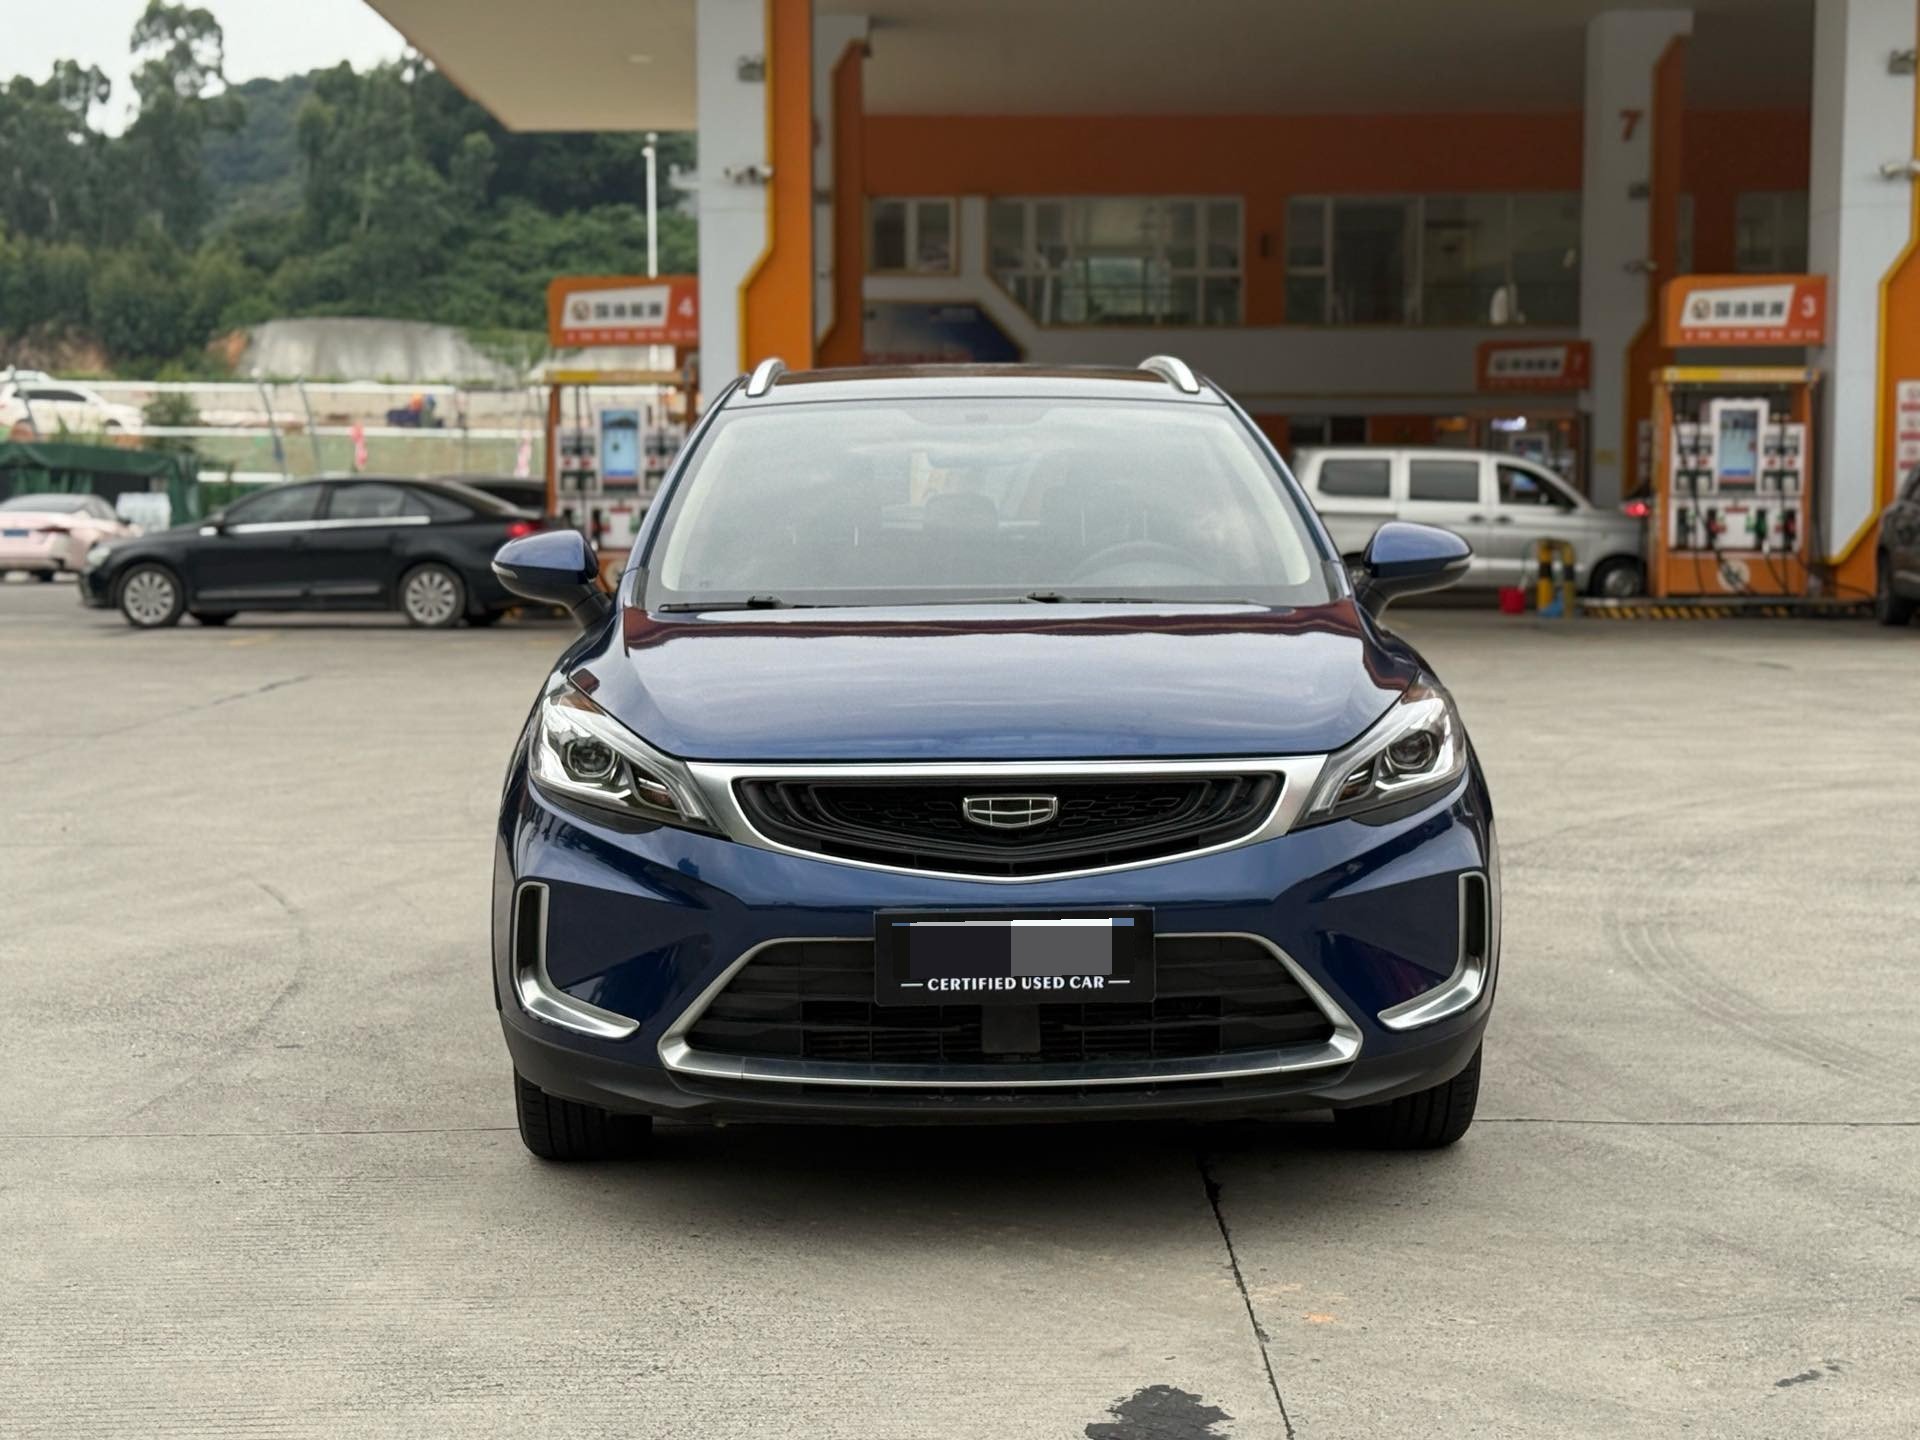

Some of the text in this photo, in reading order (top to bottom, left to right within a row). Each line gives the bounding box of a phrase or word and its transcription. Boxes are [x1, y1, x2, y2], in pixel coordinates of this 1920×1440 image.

[1619, 109, 1644, 142] 7
[677, 296, 693, 317] 4
[1802, 296, 1816, 318] 3
[927, 976, 1105, 991] CERTIFIED USED CAR
